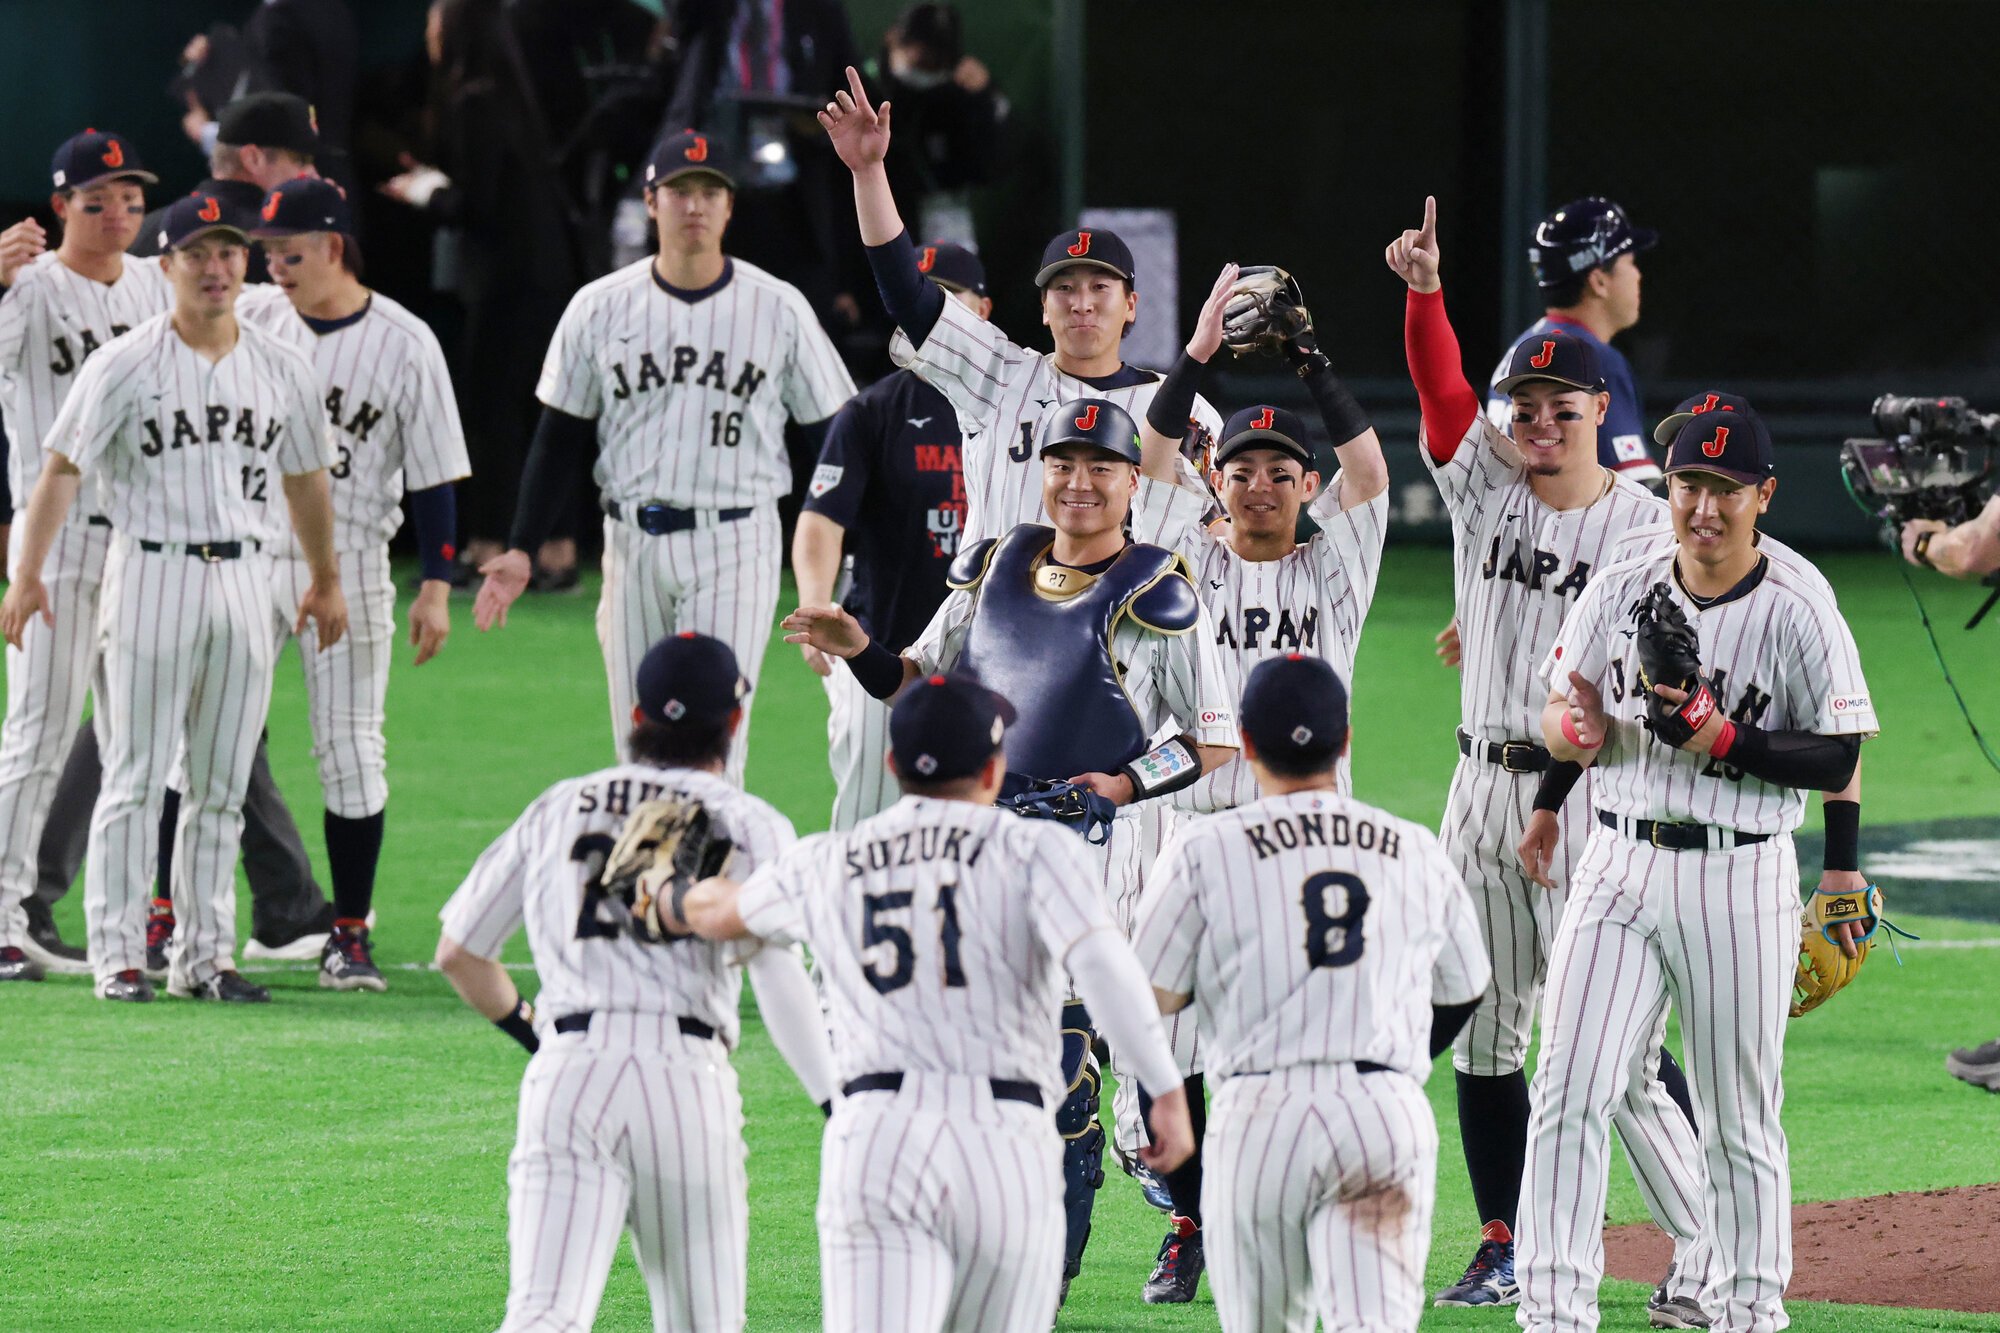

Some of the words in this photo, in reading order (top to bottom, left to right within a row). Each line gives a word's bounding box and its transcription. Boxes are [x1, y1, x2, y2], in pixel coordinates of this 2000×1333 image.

[685, 137, 707, 162] J
[917, 248, 936, 272] J
[1067, 232, 1091, 257] J
[1530, 341, 1556, 368] J
[613, 346, 766, 403] JAPAN
[140, 404, 282, 457] JAPAN
[711, 411, 743, 447] 16
[1074, 404, 1099, 431] J
[1250, 408, 1274, 430] J
[1702, 426, 1729, 458] J
[241, 465, 267, 502] 12
[1049, 572, 1067, 588] 27
[1483, 536, 1591, 601] JAPA
[1216, 606, 1318, 650] APAN
[1848, 698, 1868, 707] MUFG
[847, 826, 986, 878] SUZUKI
[1245, 813, 1400, 860] KONDOH
[1300, 871, 1372, 970] 8
[862, 884, 968, 995] 51
